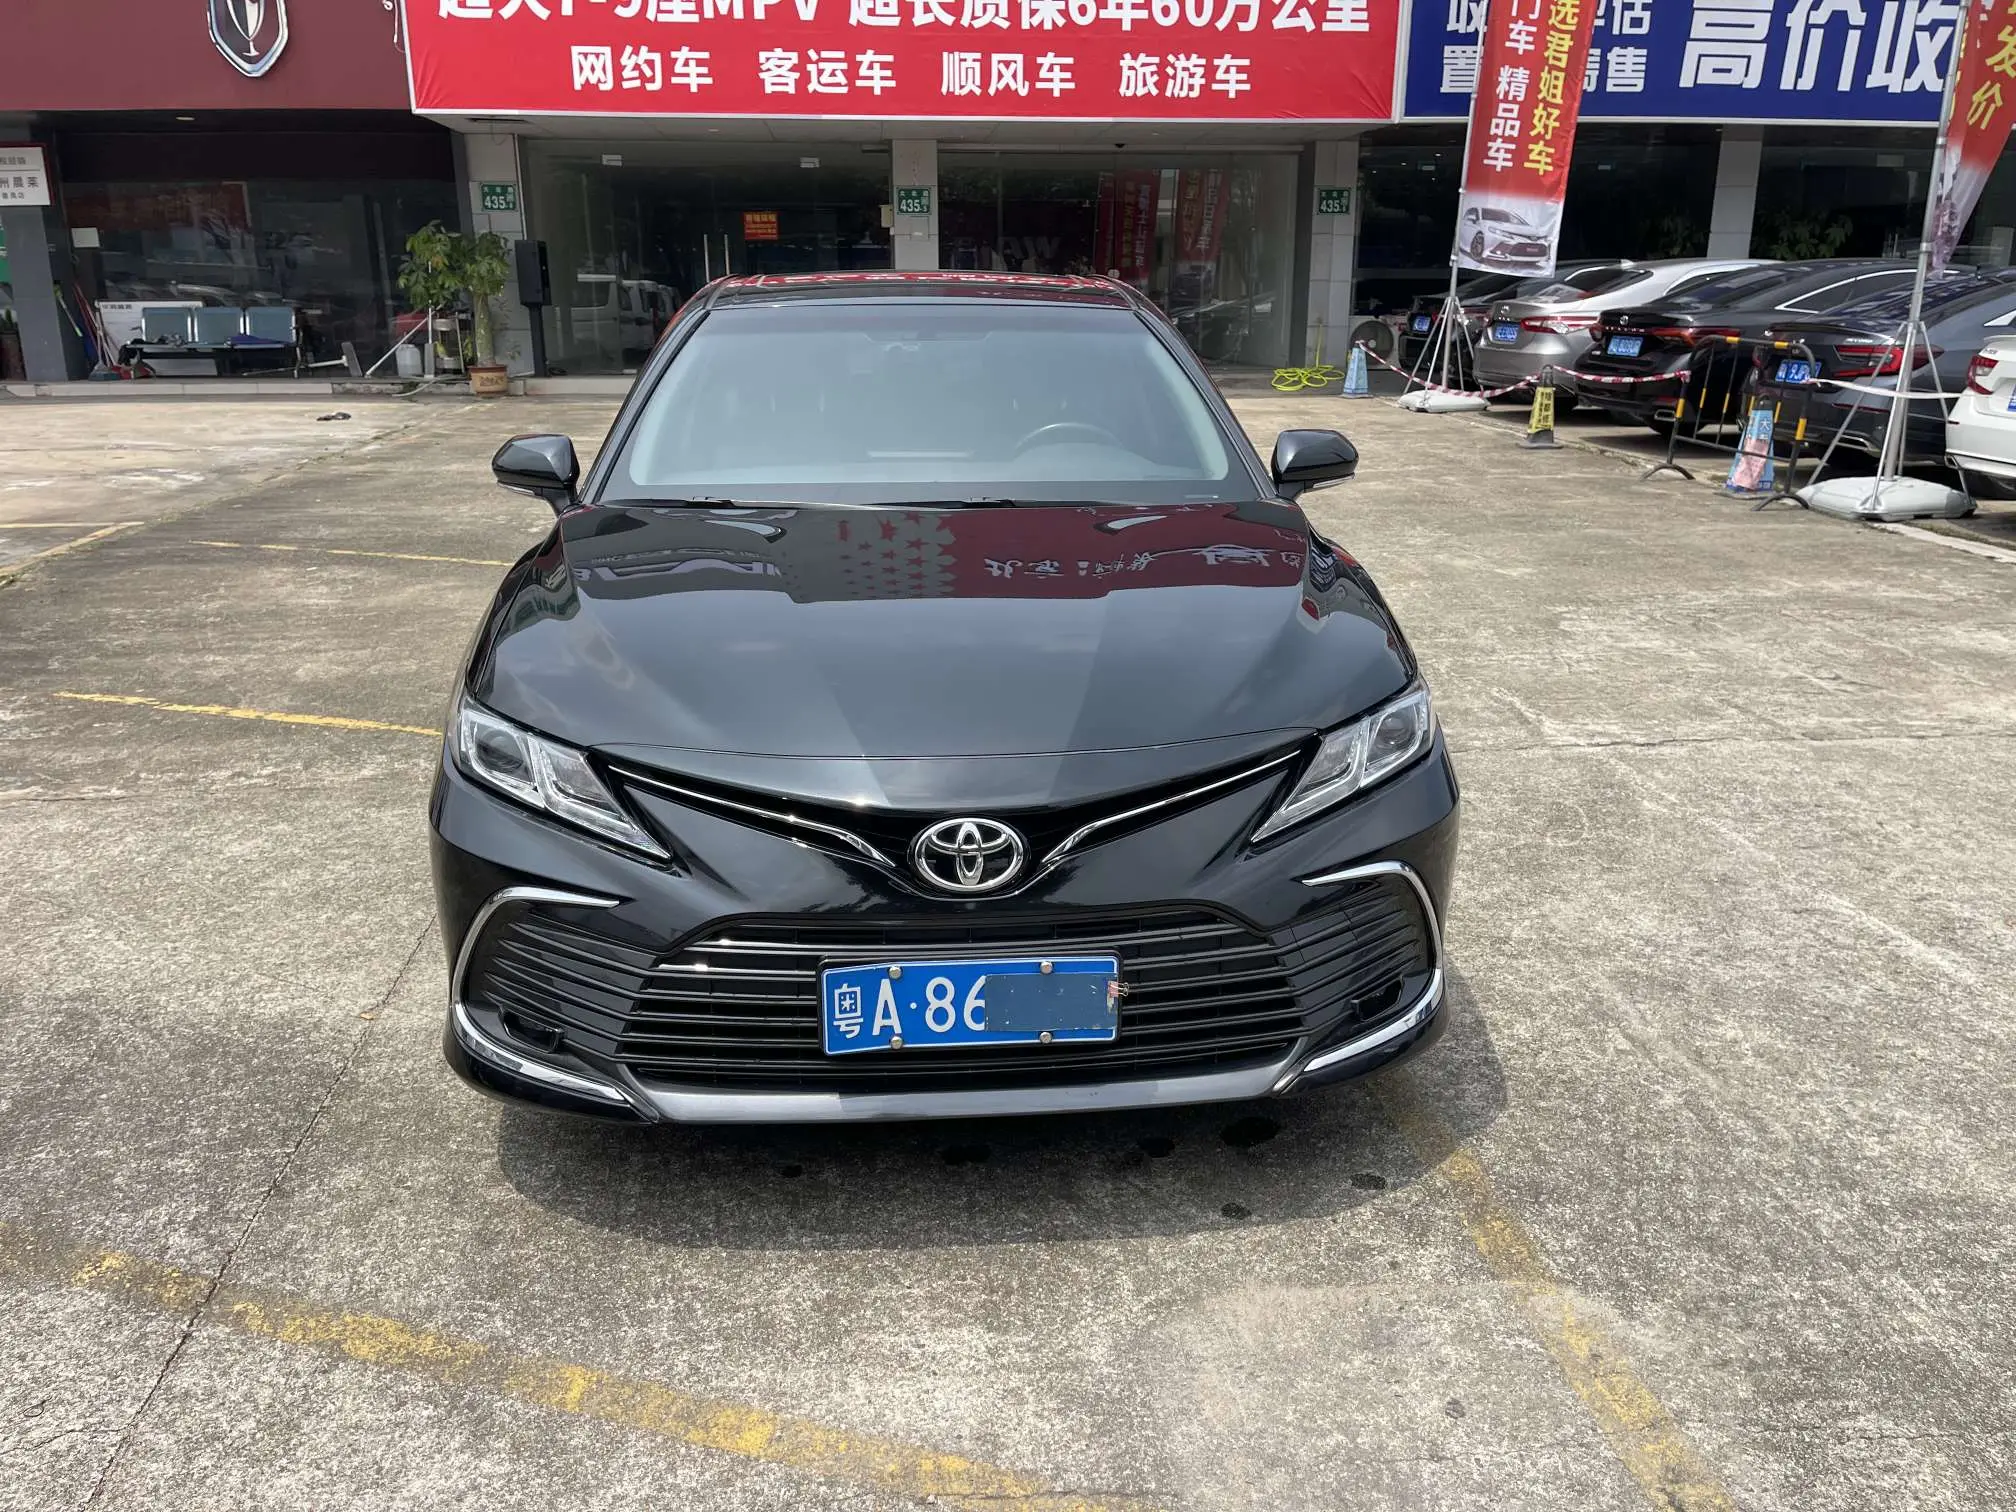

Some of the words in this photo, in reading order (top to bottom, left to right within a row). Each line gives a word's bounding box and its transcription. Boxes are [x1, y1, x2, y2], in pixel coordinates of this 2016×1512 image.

[570, 44, 713, 93] 网约车
[757, 47, 897, 96] 客运车
[941, 51, 1076, 98] 顺风车
[1118, 53, 1251, 99] 旅游车
[1483, 64, 1530, 172] 精品车
